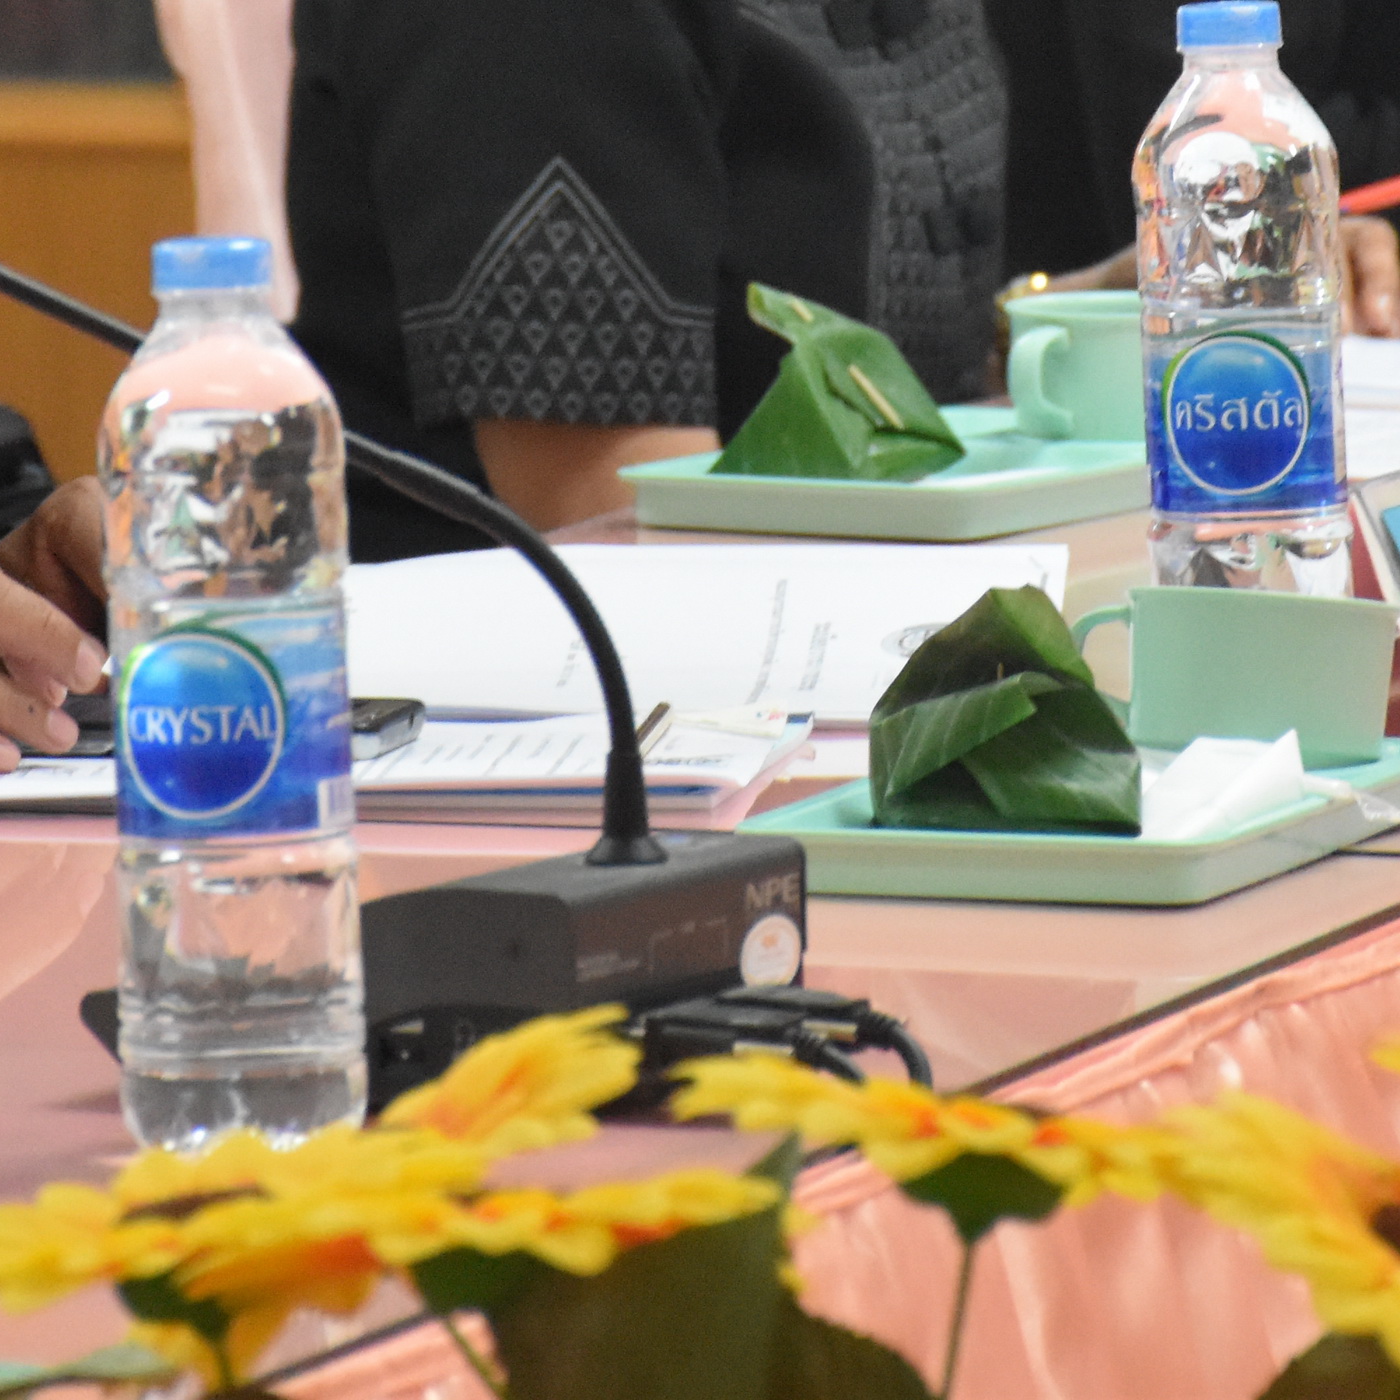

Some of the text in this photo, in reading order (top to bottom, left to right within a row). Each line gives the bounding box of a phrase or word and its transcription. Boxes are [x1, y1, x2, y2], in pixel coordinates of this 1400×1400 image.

[1175, 389, 1303, 432] คริสตัล
[130, 705, 275, 744] CRYSTAL
[747, 871, 800, 909] NPE
